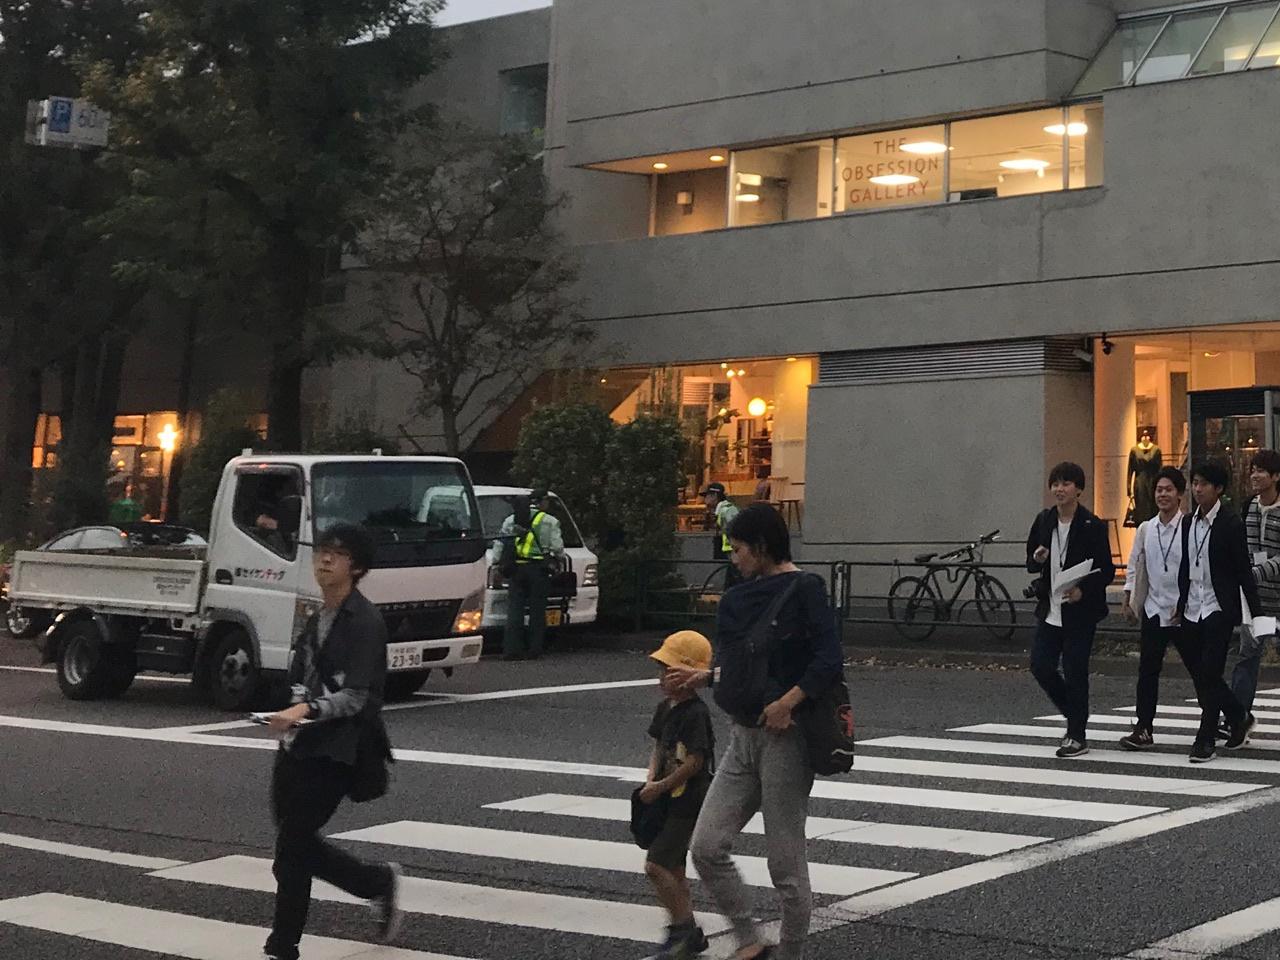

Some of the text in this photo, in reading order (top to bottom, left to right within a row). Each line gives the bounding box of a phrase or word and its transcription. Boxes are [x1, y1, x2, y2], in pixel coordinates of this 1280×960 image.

[873, 137, 907, 155] THE
[841, 157, 938, 182] OBSESSION
[849, 180, 929, 204] GALLERY
